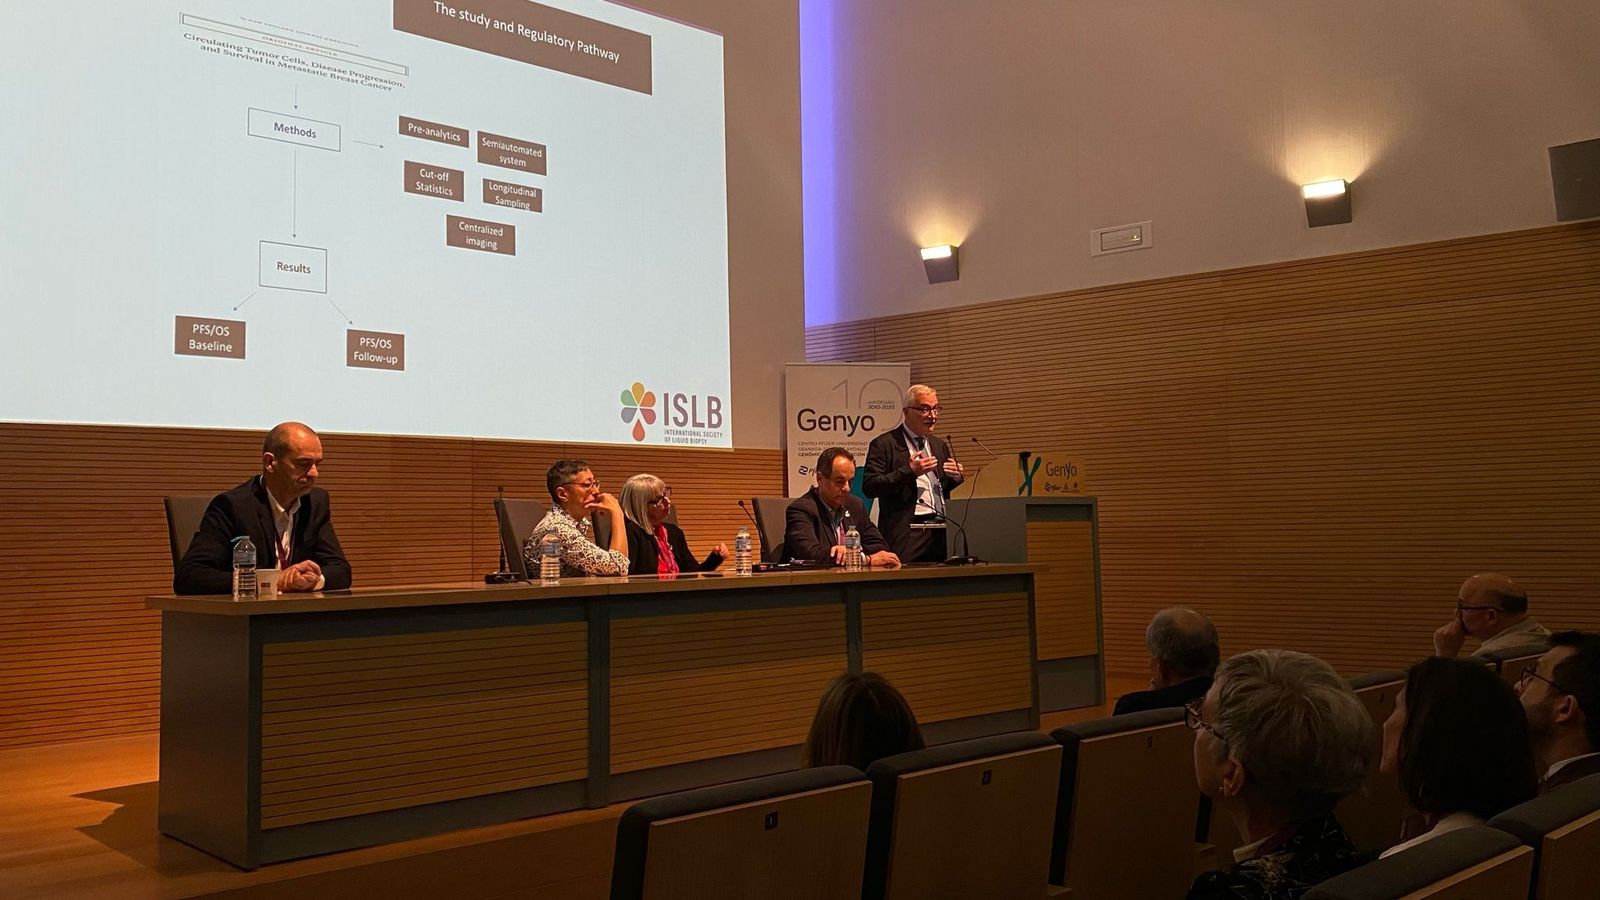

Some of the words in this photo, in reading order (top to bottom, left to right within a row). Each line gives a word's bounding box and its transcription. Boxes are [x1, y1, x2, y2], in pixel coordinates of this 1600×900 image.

[434, 1, 456, 17] The
[459, 10, 490, 29] study
[493, 17, 514, 33] and
[517, 24, 575, 51] Regulatory
[577, 40, 620, 64] Pathway
[183, 33, 243, 52] Circulating
[245, 46, 279, 59] Tumor
[281, 55, 309, 66] Cells,
[311, 61, 347, 74] Disease
[349, 70, 406, 88] Progression,
[200, 45, 220, 54] and
[223, 49, 263, 63] Survival
[265, 57, 275, 66] in
[277, 61, 328, 77] Metastatic
[330, 73, 359, 85] Breast
[360, 79, 393, 92] Cancer
[273, 122, 317, 139] Methods
[408, 122, 461, 142] Pre-analytics
[481, 137, 542, 158] Semiautomated
[499, 154, 527, 167] system
[419, 168, 449, 182] Cut-off
[415, 181, 453, 196] Statistics
[489, 181, 537, 198] Longitudinal
[495, 195, 530, 211] Sampling
[458, 221, 503, 237] Centralized
[465, 235, 498, 251] imaging
[276, 260, 311, 275] Results
[192, 323, 230, 337] PFS/OS
[188, 339, 233, 353] Baseline
[359, 336, 392, 350] PFS/OS
[353, 350, 398, 365] Follow-up
[663, 392, 723, 429] ISLB
[797, 408, 876, 438] Genyo
[664, 429, 701, 437] INTERNATIONAL
